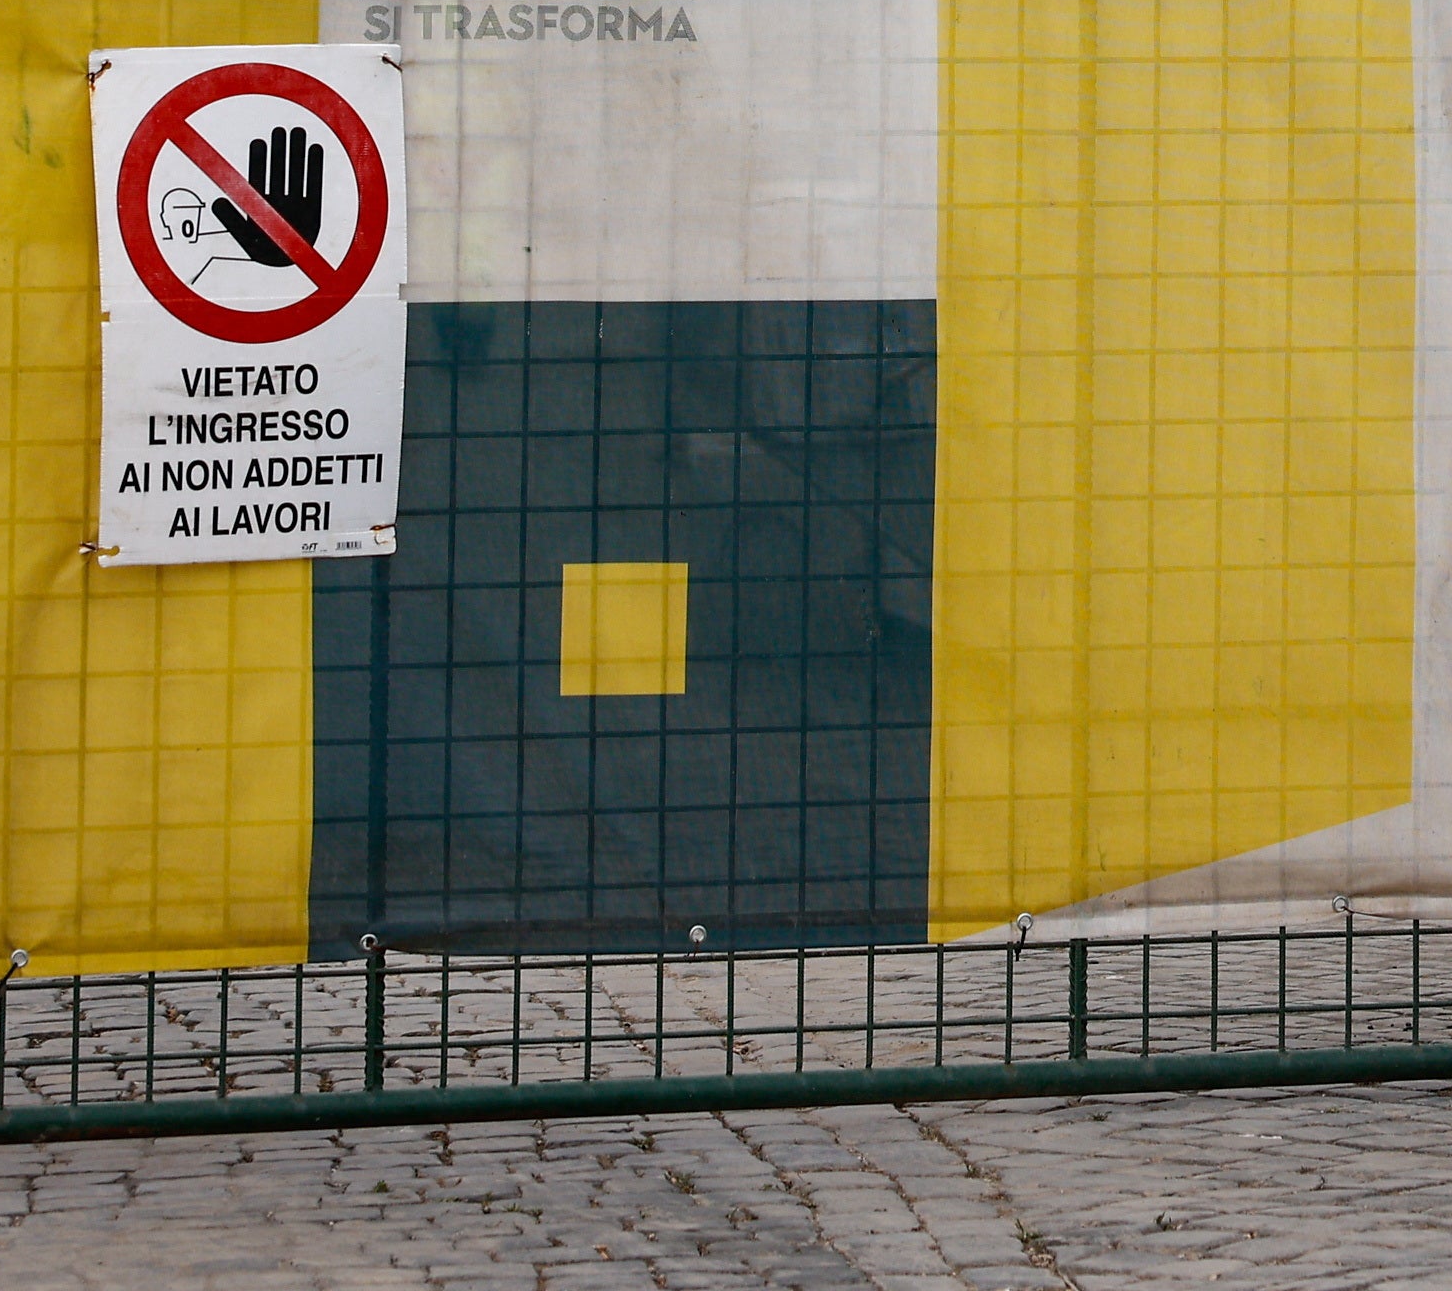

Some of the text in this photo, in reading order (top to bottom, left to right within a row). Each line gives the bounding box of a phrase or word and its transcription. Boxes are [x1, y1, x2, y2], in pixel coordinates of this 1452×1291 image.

[363, 4, 698, 43] SI TRASFORMA
[181, 363, 319, 398] VIETATO
[148, 408, 350, 446] L'INGRESSO
[118, 453, 383, 494] AI NON ADDETTI
[168, 501, 331, 538] AI LAVORI
